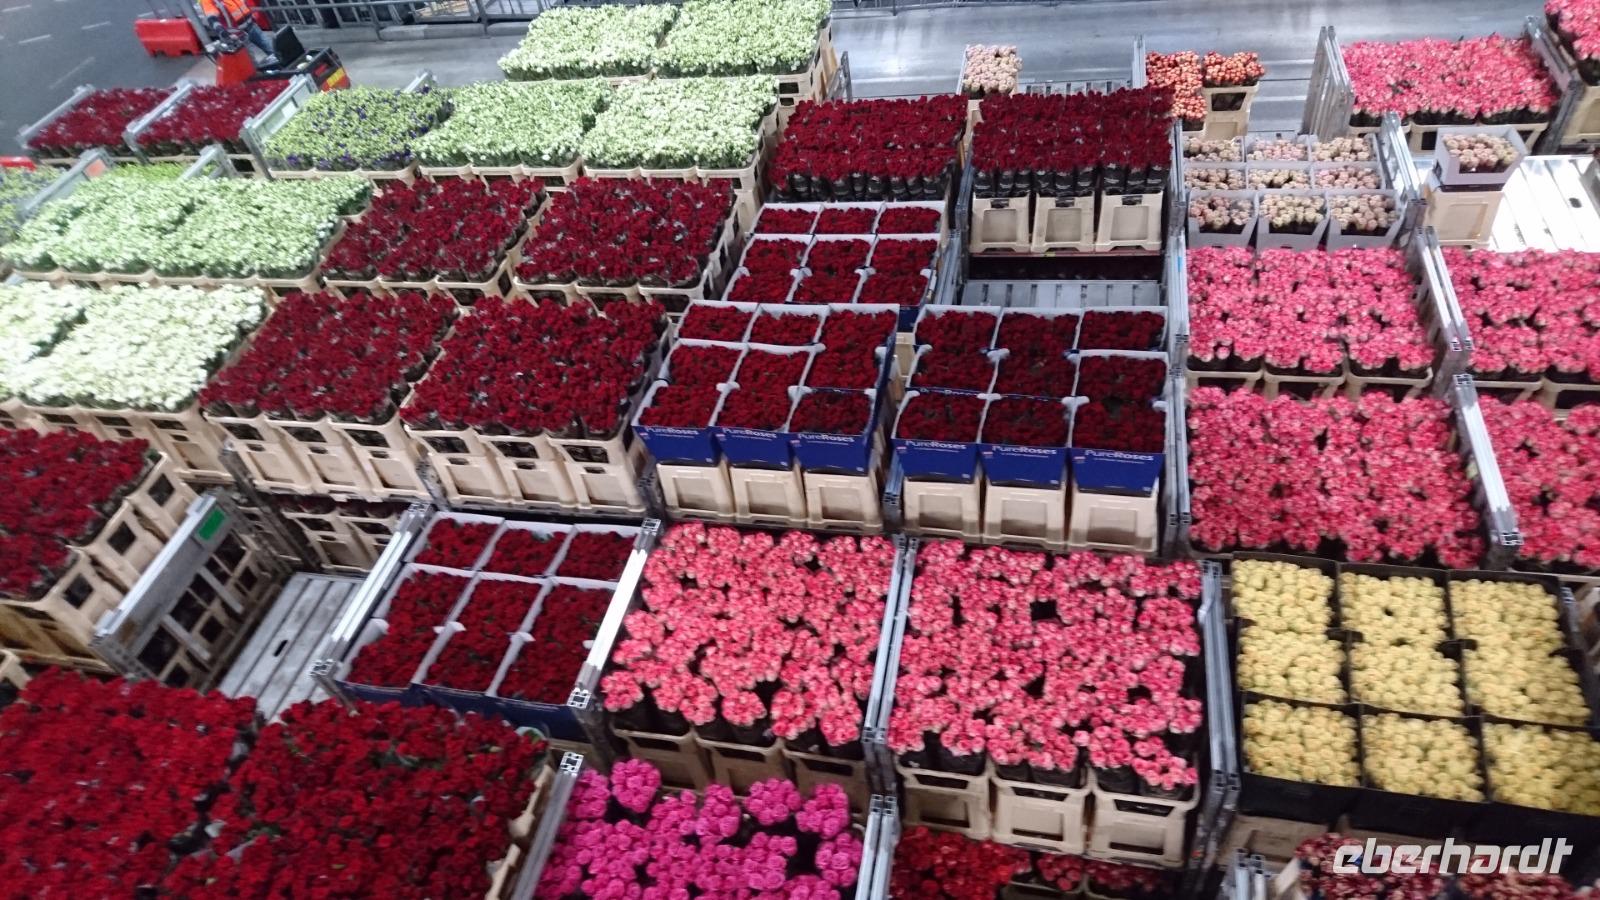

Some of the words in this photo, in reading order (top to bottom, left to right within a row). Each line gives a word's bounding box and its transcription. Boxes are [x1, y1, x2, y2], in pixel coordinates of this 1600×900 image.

[645, 426, 699, 435] PureRoses
[722, 427, 777, 438] PureRoses
[798, 433, 855, 442] PureRoses
[905, 439, 967, 449] PureRoses
[992, 445, 1057, 455] PureRoses
[1084, 449, 1154, 461] PureRoses
